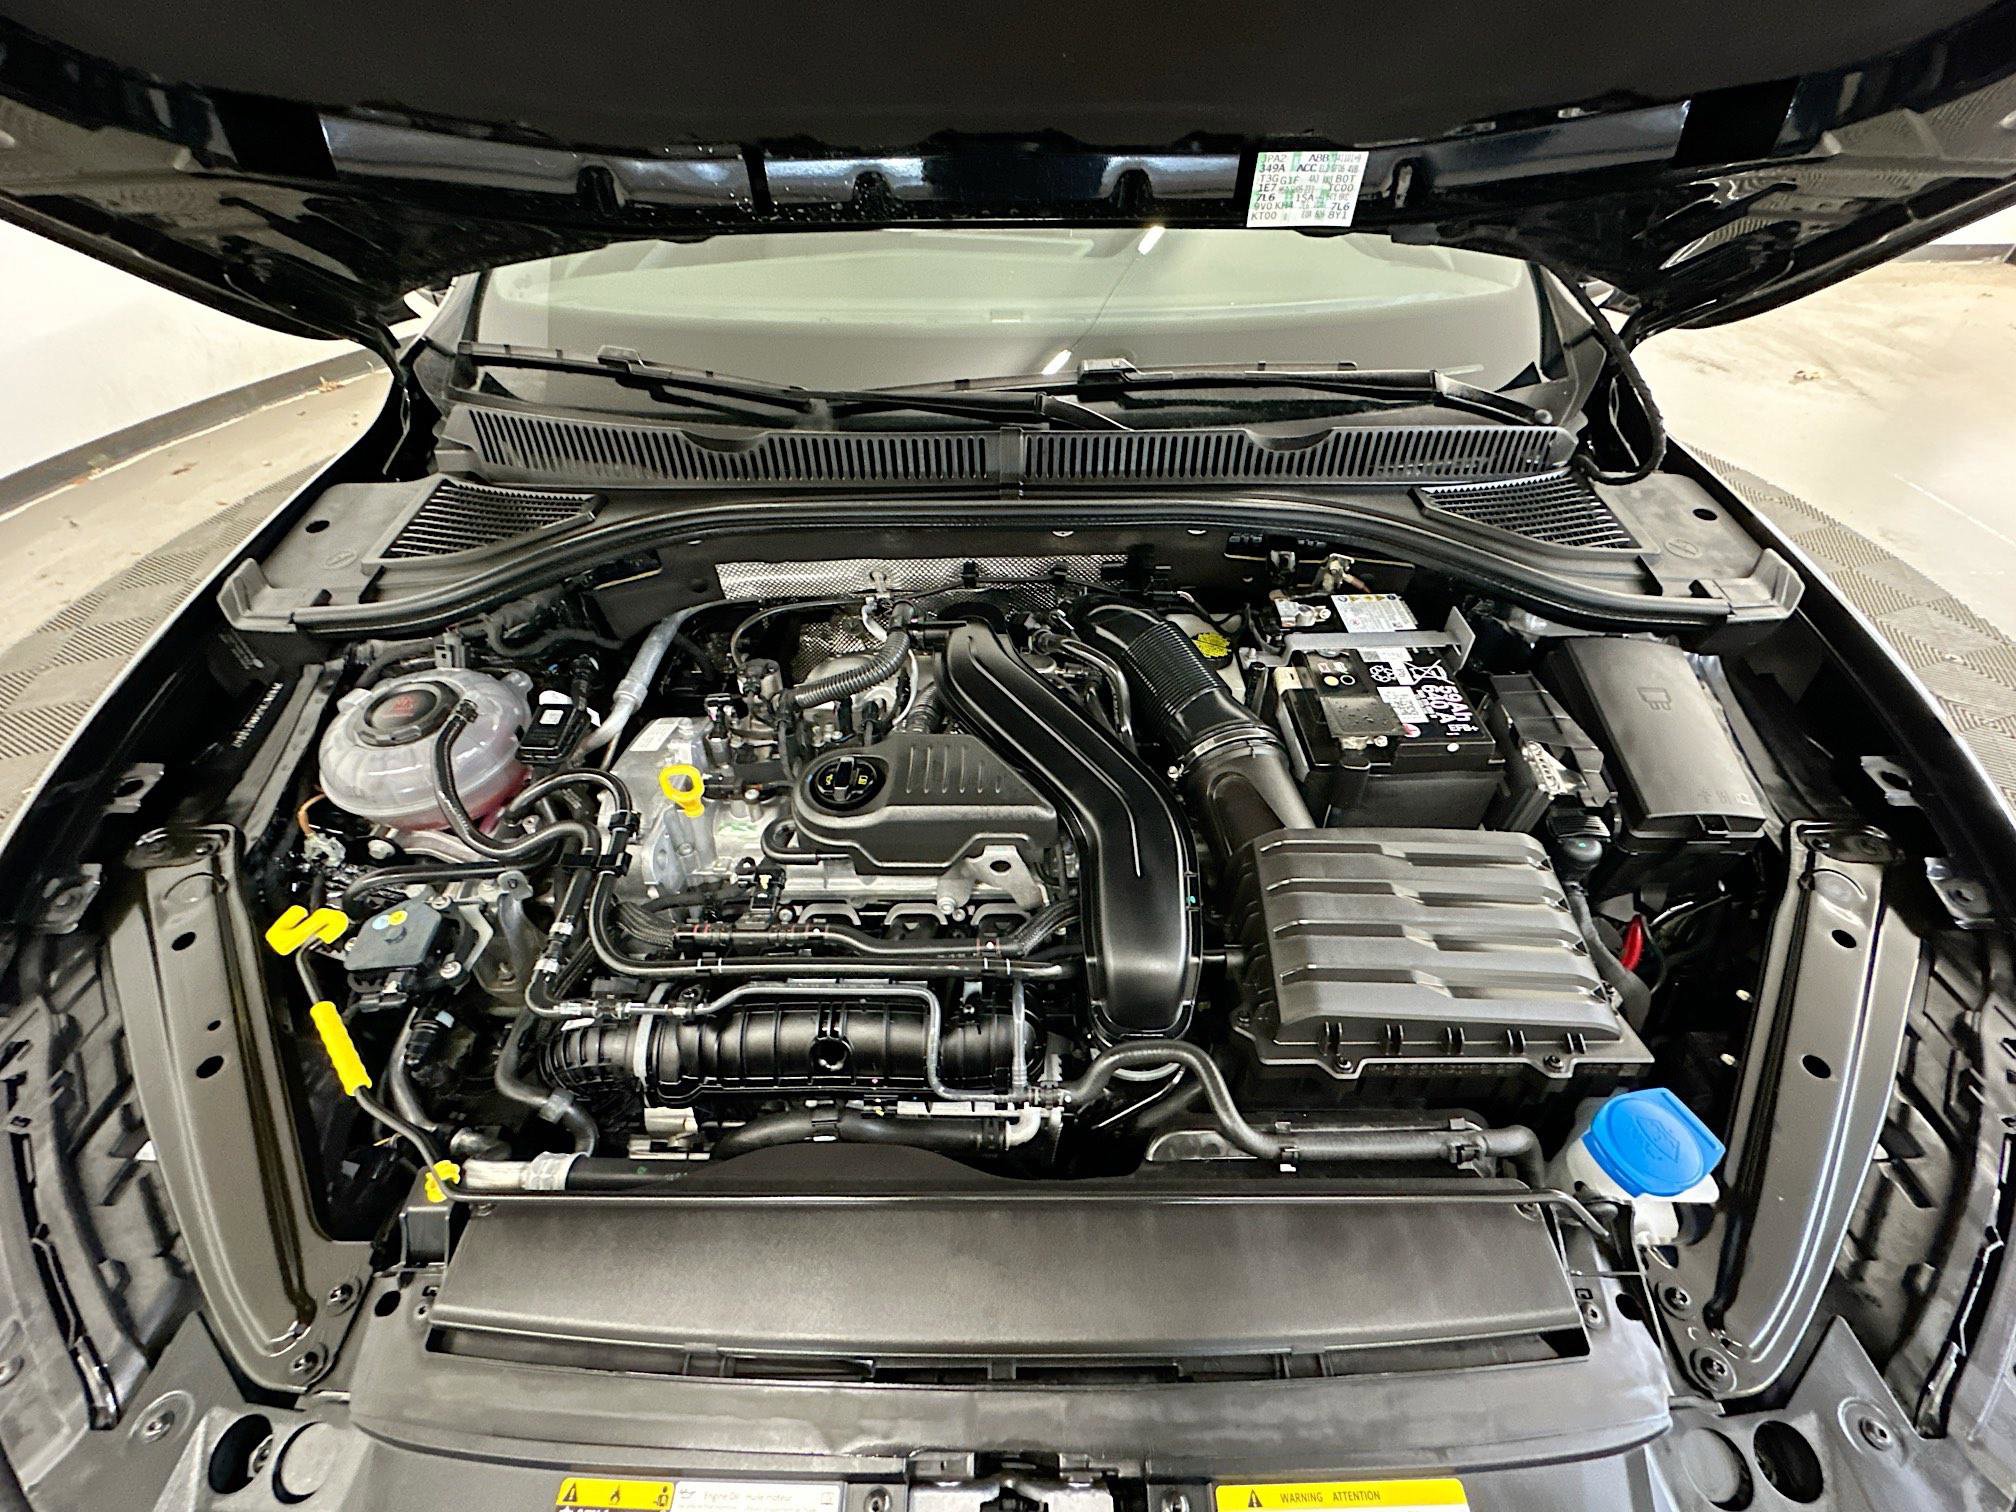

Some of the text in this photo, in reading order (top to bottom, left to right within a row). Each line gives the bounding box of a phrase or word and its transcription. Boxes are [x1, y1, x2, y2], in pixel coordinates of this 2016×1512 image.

[1259, 164, 1285, 173] 349A
[1258, 184, 1277, 192] 1E7
[1256, 193, 1275, 201] 7L6
[1331, 202, 1350, 210] 7L6
[1279, 1490, 1381, 1504] WARNING ATTENTION
